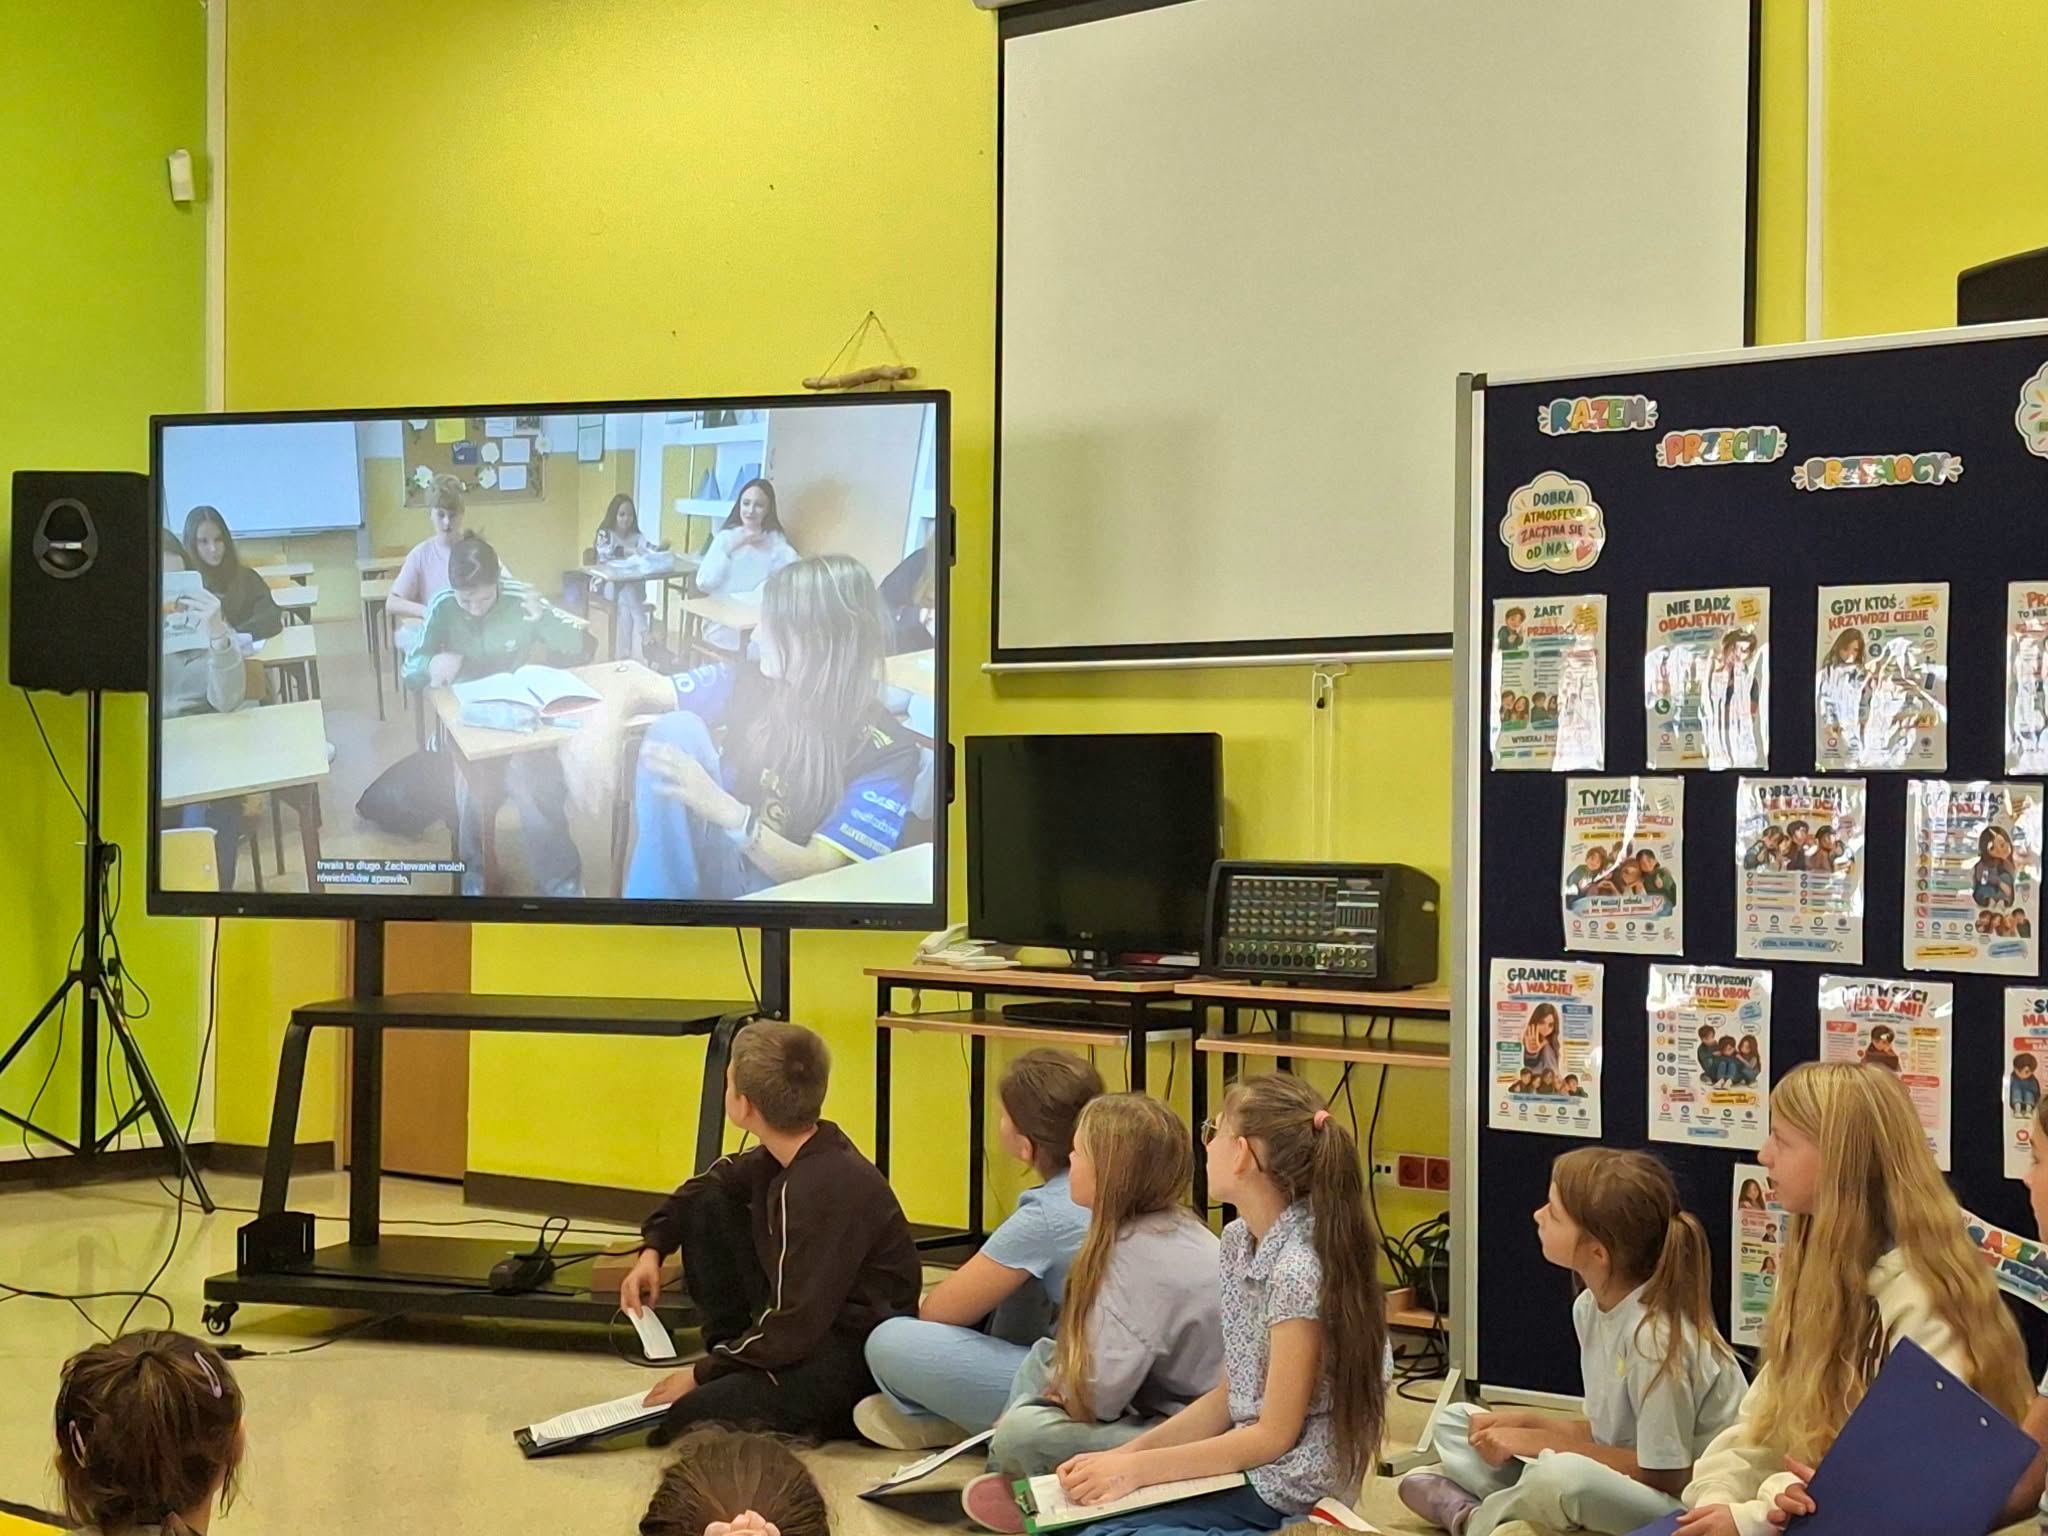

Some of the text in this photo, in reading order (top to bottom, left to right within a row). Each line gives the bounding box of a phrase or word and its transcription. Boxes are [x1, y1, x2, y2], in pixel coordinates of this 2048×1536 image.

[1550, 397, 1646, 433] RAZEM
[1665, 428, 1778, 465] PRZECIW
[1533, 489, 1575, 506] DOBRA
[1523, 508, 1582, 525] ATMOSFERA
[1520, 523, 1584, 544] ZACZYNA SIĘ
[1526, 541, 1570, 560] OD NAS
[1533, 605, 1565, 618] ŻART
[1666, 600, 1690, 617] NIE
[1694, 595, 1731, 613] BĄDŹ
[1830, 599, 1861, 616] GDY
[1864, 593, 1897, 611] KTOŚ
[1658, 612, 1735, 633] OBOJĘTNY!
[1828, 609, 1929, 631] KRZYWDZI CIEBIE
[2018, 610, 2030, 619] TO
[1507, 967, 1567, 983] GRANICE
[1507, 983, 1573, 997] SĄ WAŻNE!
[1722, 987, 1751, 999] OBOK
